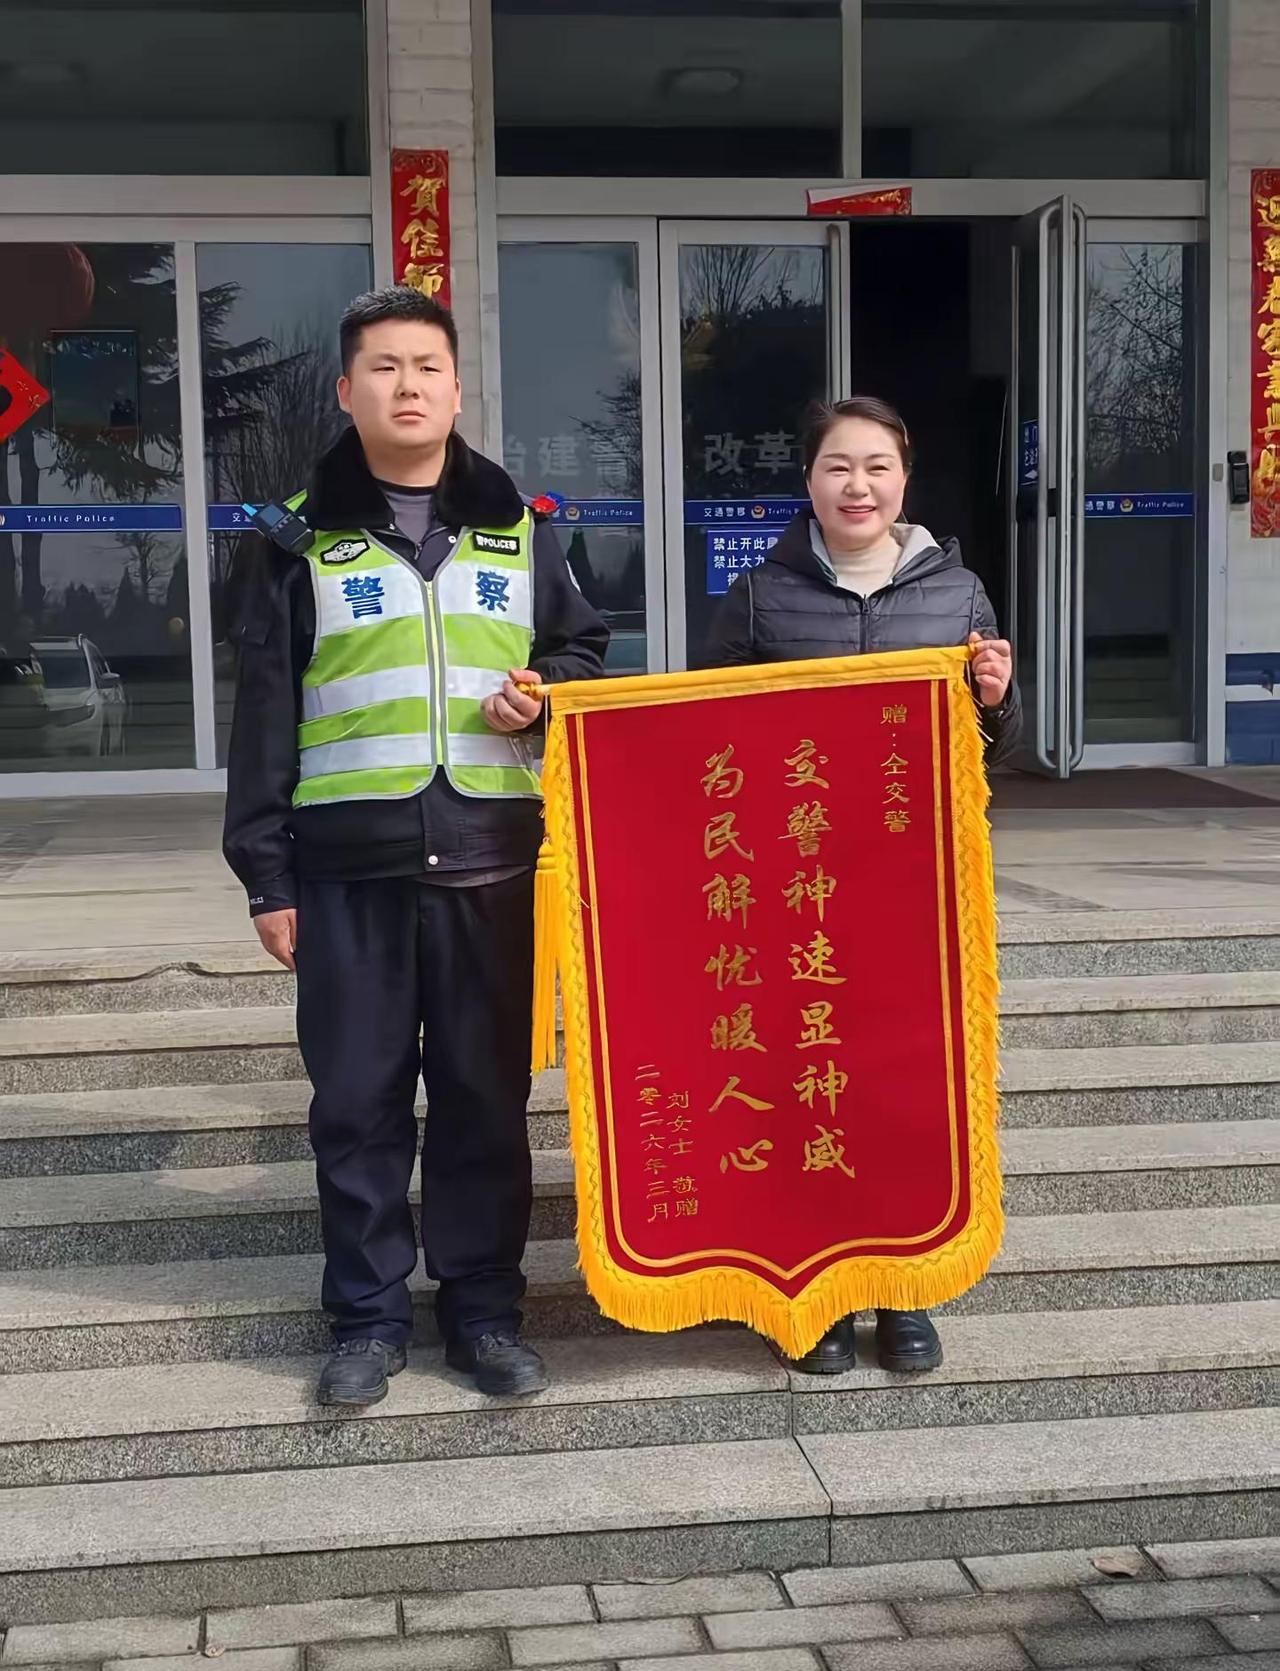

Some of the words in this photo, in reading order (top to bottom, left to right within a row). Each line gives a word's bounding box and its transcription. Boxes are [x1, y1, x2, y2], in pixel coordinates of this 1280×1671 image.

[26, 515, 70, 523] Traffic
[76, 514, 115, 523] Police
[713, 554, 766, 569] 禁止大力
[341, 575, 385, 619] 警
[475, 571, 510, 612] 察
[700, 744, 775, 1174] 为民解忧暖人心
[778, 739, 856, 1178] 交警神速显神威
[635, 1064, 670, 1223] 二零二六年三月
[666, 1091, 694, 1155] 刘女士
